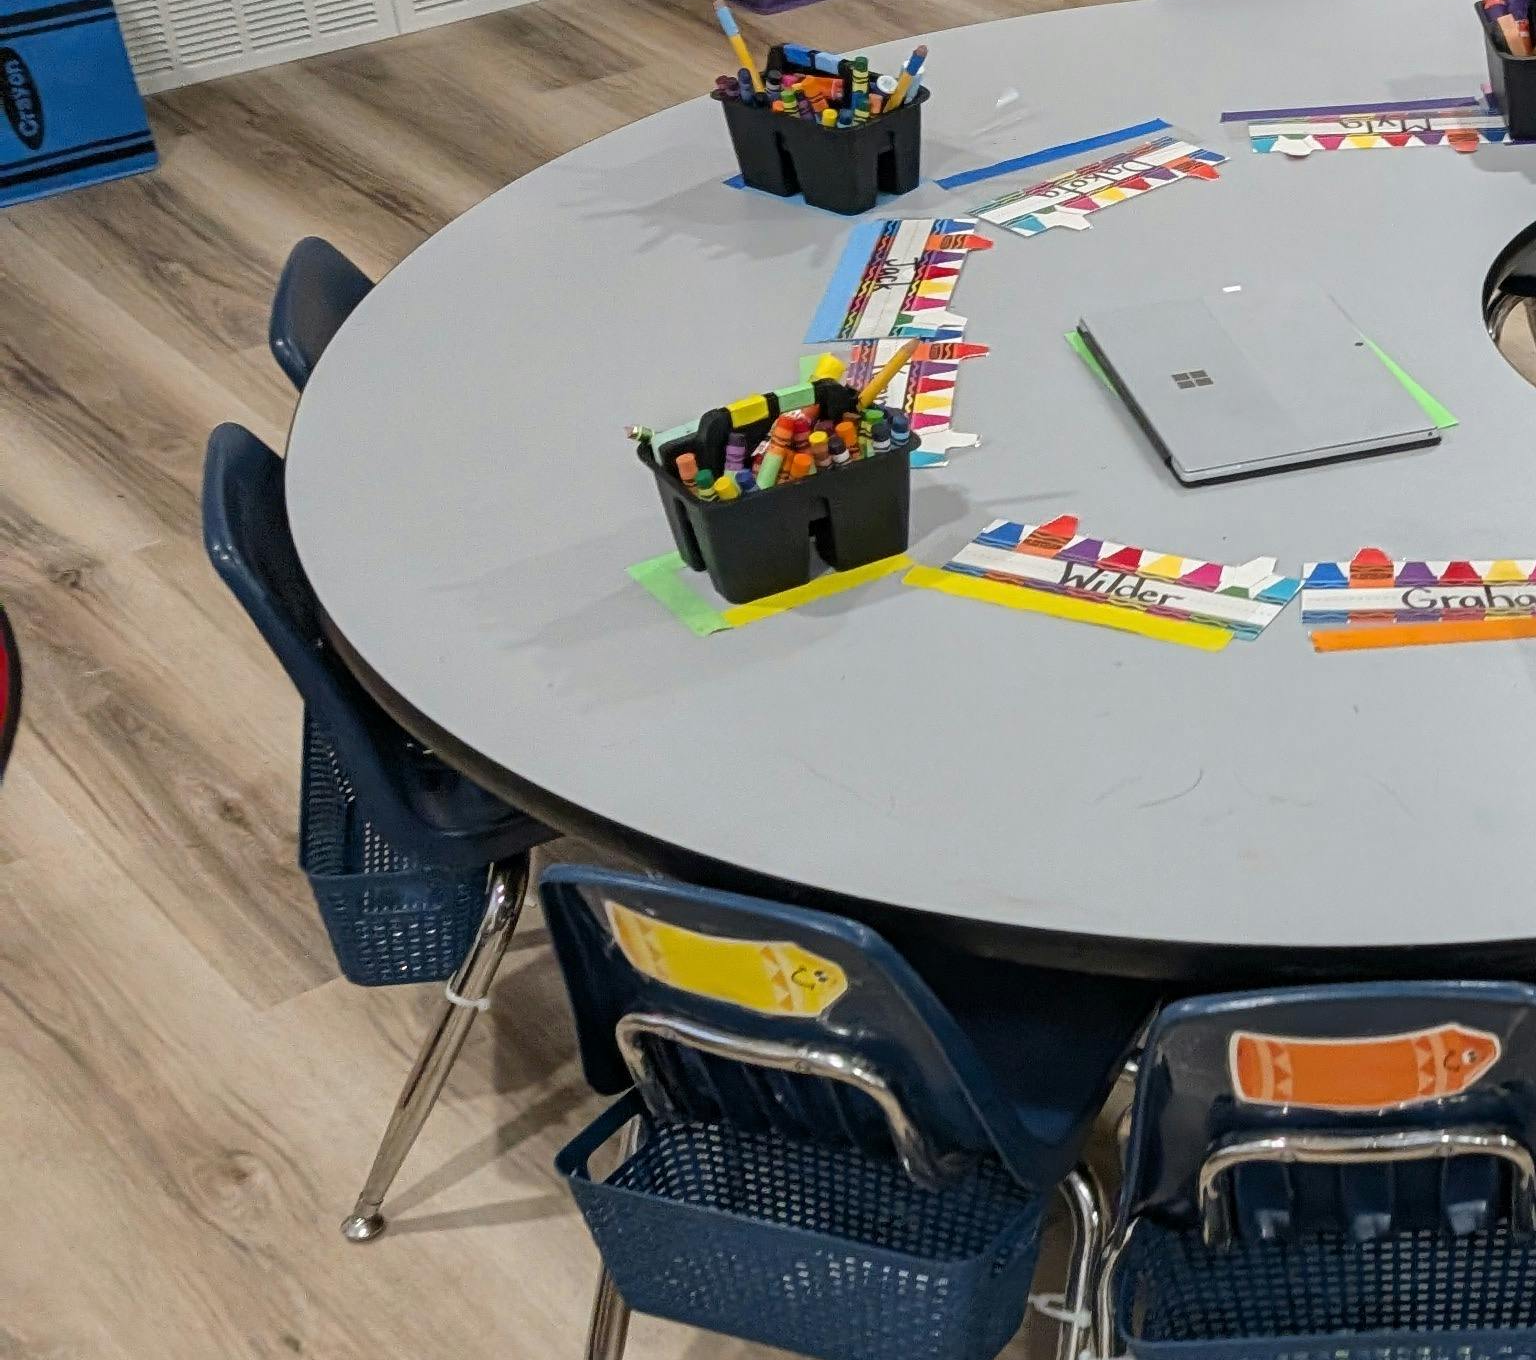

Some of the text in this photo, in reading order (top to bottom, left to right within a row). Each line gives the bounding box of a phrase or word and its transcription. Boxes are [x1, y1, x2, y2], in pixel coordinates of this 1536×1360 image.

[4, 59, 39, 137] Crayon
[1340, 114, 1431, 133] Myla
[1044, 160, 1160, 198] Dakota
[872, 256, 920, 291] Jack
[1059, 560, 1186, 606] Wilder
